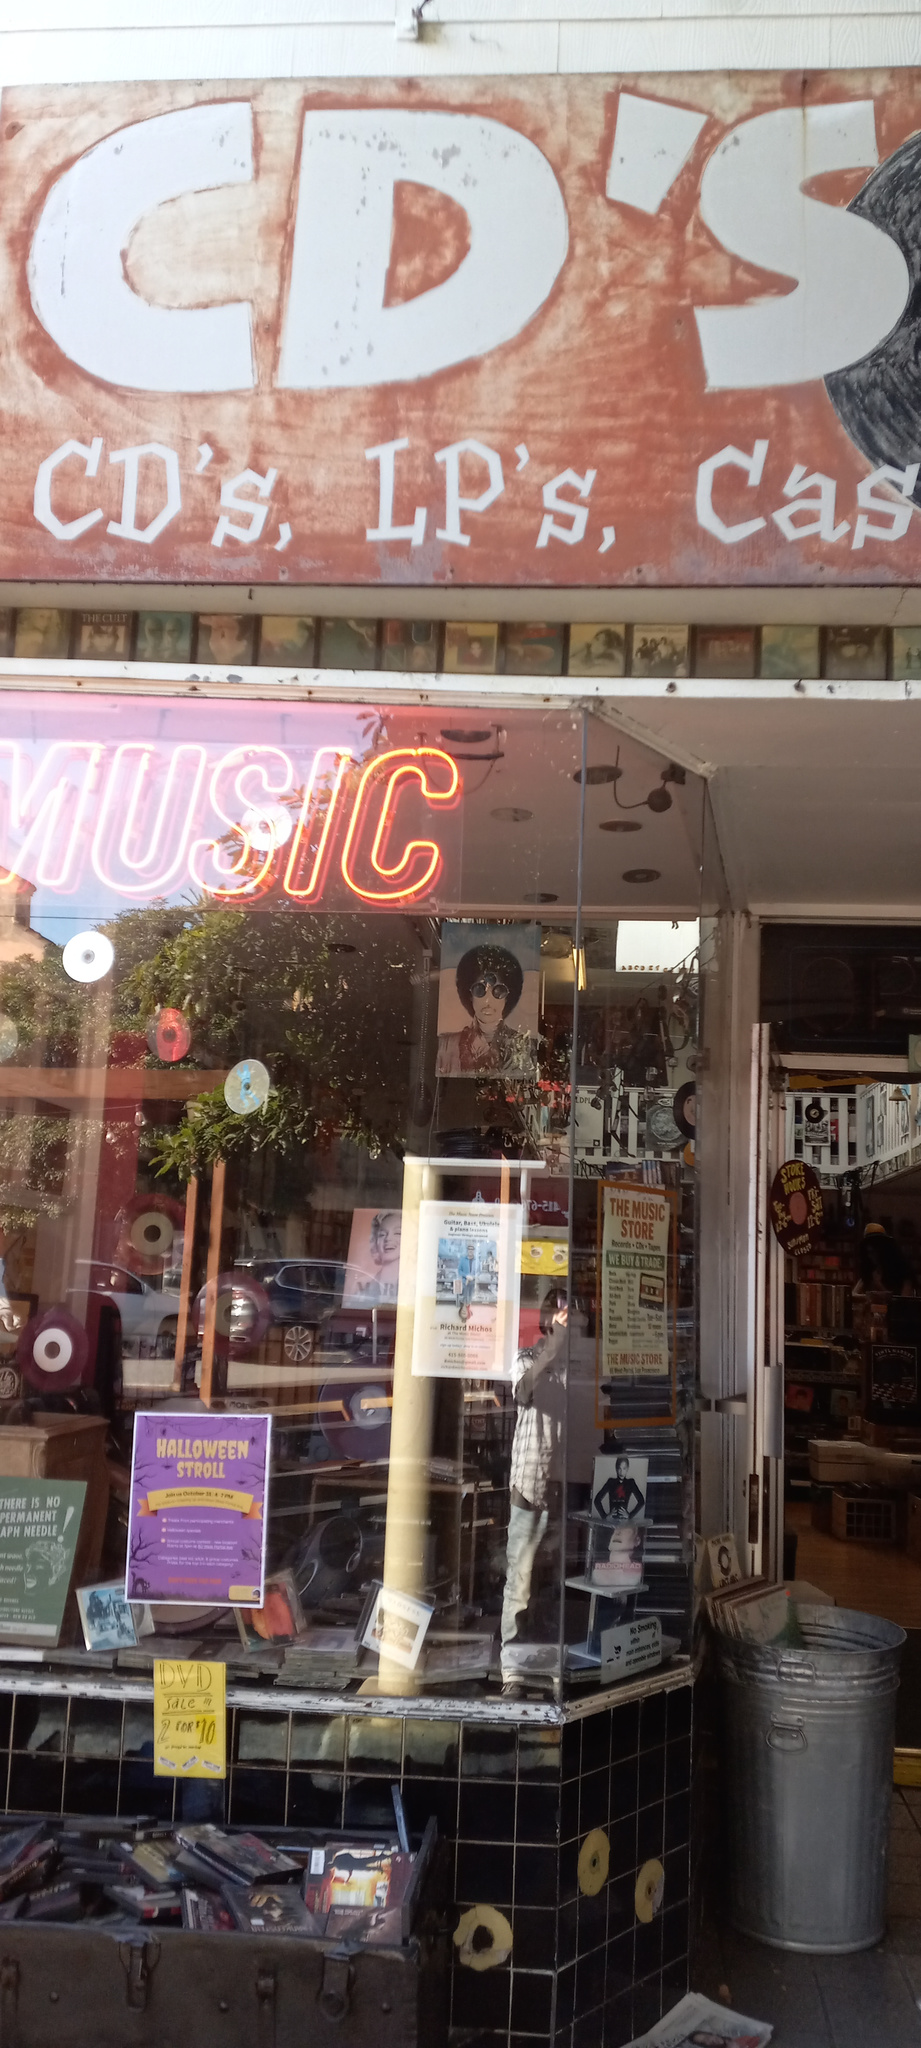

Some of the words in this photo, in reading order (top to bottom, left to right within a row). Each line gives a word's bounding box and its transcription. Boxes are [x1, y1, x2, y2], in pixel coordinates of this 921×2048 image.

[27, 93, 911, 392] CD'S
[34, 437, 292, 551] CD's,
[365, 436, 617, 552] LP's,
[82, 613, 101, 623] THE
[102, 613, 128, 624] CULT
[0, 742, 460, 900] MUSIC
[781, 1162, 805, 1184] STORE
[610, 1198, 630, 1218] THE
[632, 1200, 666, 1222] MUSIC
[621, 1219, 654, 1241] STORE
[608, 1253, 620, 1265] WE
[621, 1254, 634, 1266] BUY
[440, 1323, 467, 1331] Richard
[607, 1353, 619, 1365] THE
[620, 1353, 640, 1365] MUSIC
[641, 1354, 662, 1365] STORE
[156, 1438, 249, 1460] HALLOWEEN
[176, 1461, 226, 1479] STROLL
[31, 1497, 40, 1508] IS
[46, 1496, 61, 1509] NO
[0, 1510, 57, 1524] PERMANENT
[24, 1525, 57, 1538] NEEDLE
[595, 1562, 641, 1570] RADIOHEAD
[629, 1626, 637, 1636] No
[637, 1621, 657, 1634] Smoking
[159, 1661, 213, 1692] DVD
[157, 1719, 171, 1744] 2
